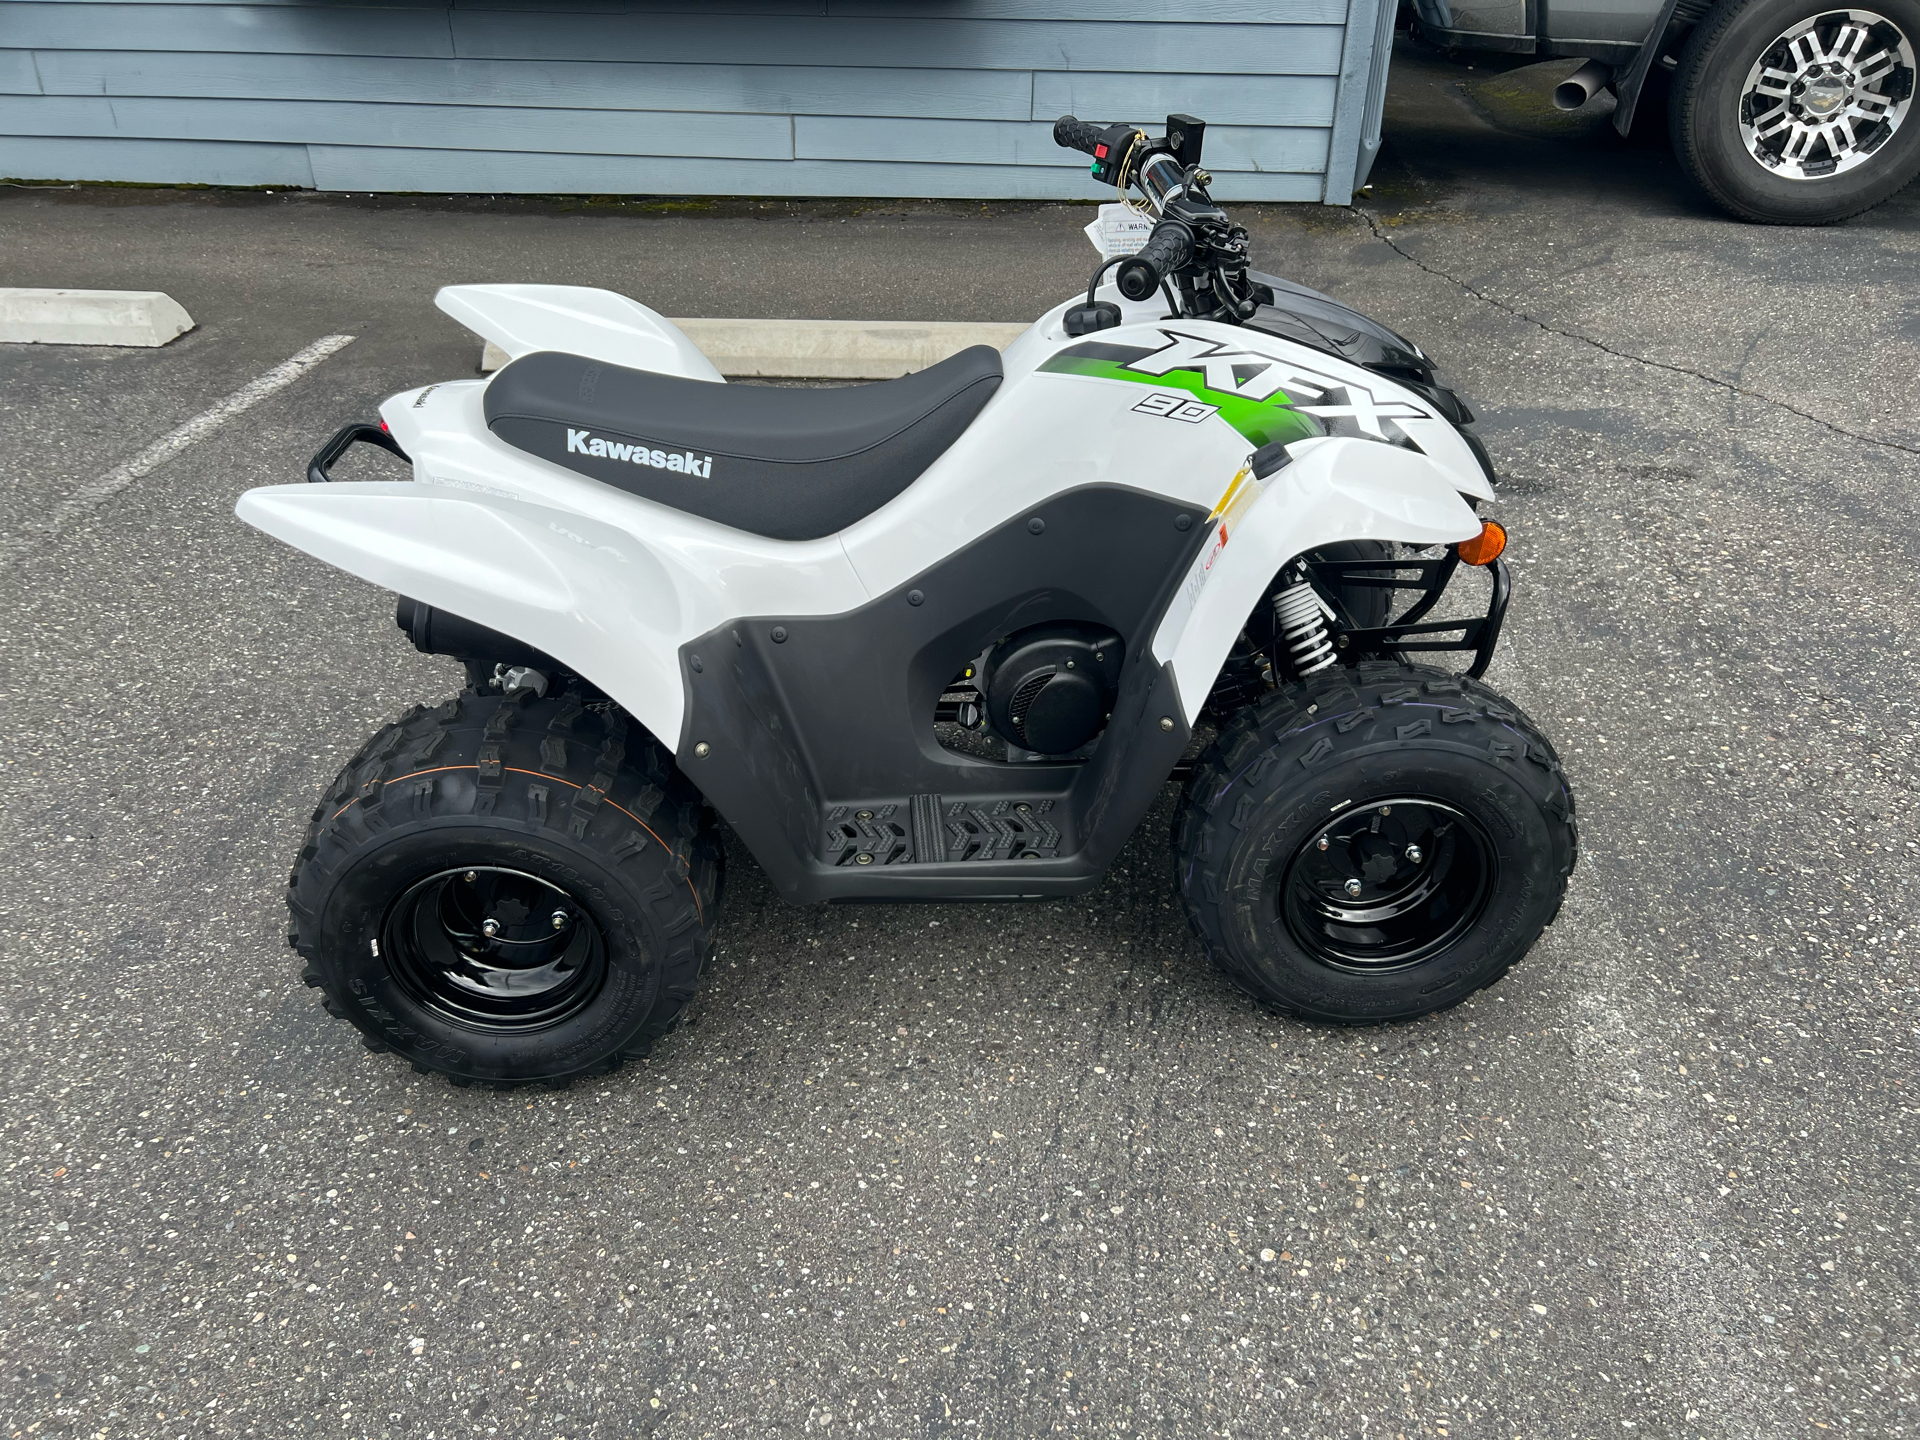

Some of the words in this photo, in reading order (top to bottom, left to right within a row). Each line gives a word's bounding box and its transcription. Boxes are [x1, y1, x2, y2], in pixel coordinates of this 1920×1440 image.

[1128, 223, 1151, 231] WARN
[1114, 328, 1434, 444] KFX
[1130, 392, 1223, 424] 90
[566, 428, 713, 479] Kawasaki
[1246, 790, 1333, 901] MAXXIS
[348, 978, 467, 1063] MAXXIS
